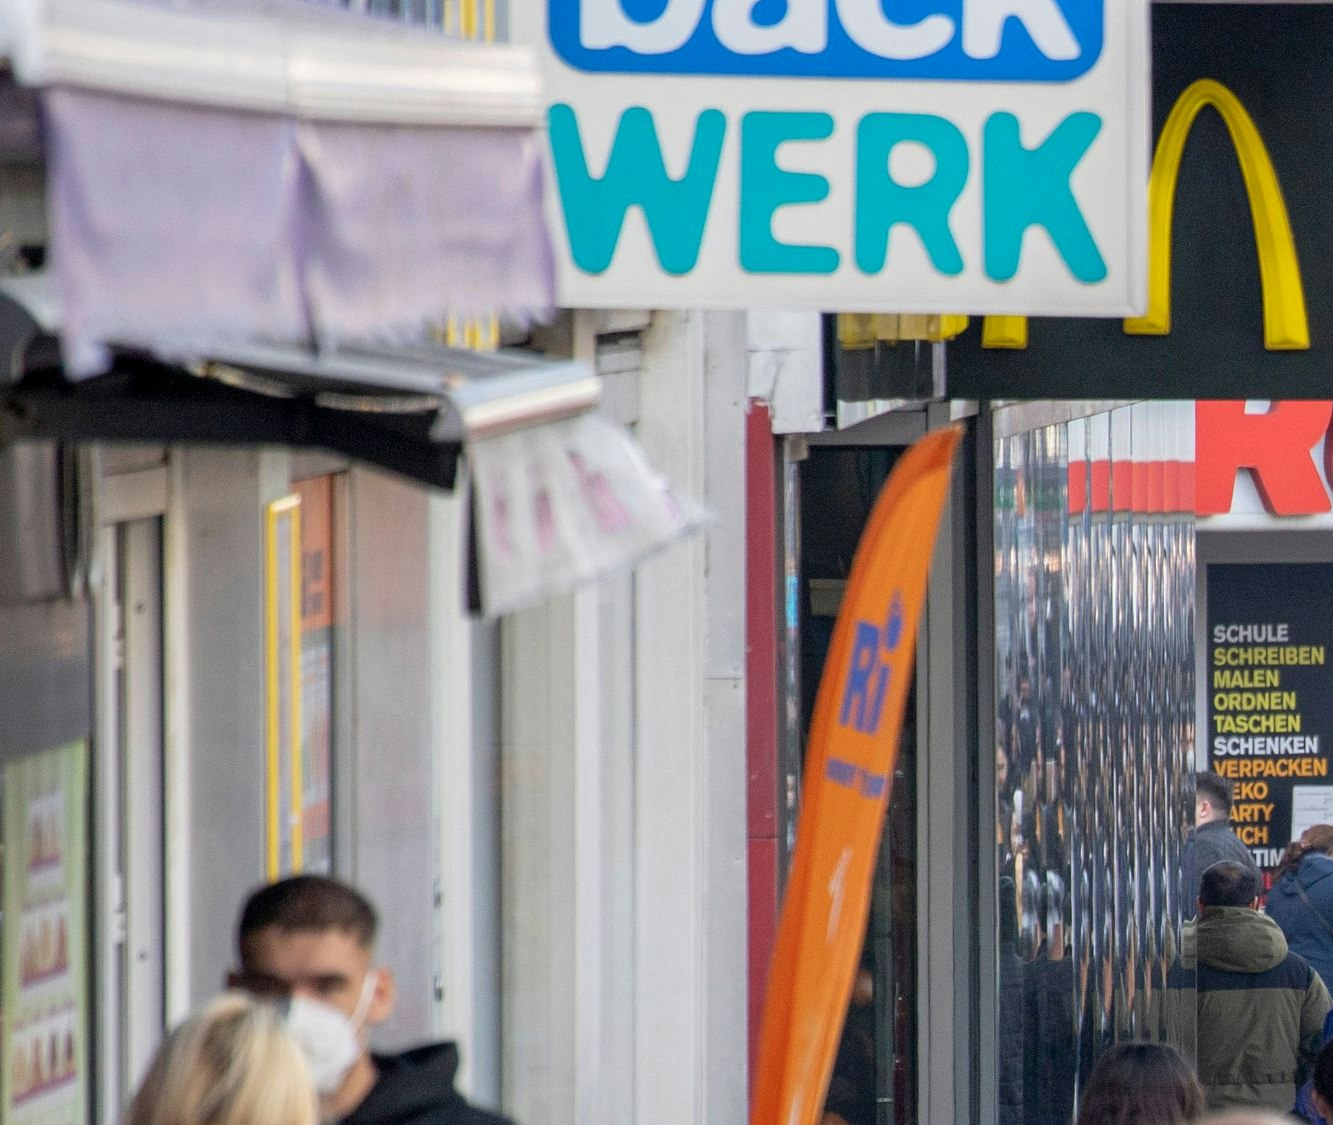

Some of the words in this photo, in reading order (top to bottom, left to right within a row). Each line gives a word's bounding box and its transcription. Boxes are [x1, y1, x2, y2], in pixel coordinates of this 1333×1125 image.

[580, 0, 1082, 61] back
[547, 103, 1108, 285] WERK
[1213, 624, 1288, 643] SCHULE
[1213, 646, 1325, 666] SCHREIBEN
[1213, 669, 1280, 688] MALEN
[1213, 691, 1296, 711] ORDNEN
[1213, 714, 1301, 734] TASCHEN
[1213, 736, 1319, 757] SCHENKEN
[1213, 758, 1328, 778] VERPACKEN
[1232, 781, 1269, 800] EKO
[1230, 803, 1275, 823] ARTY
